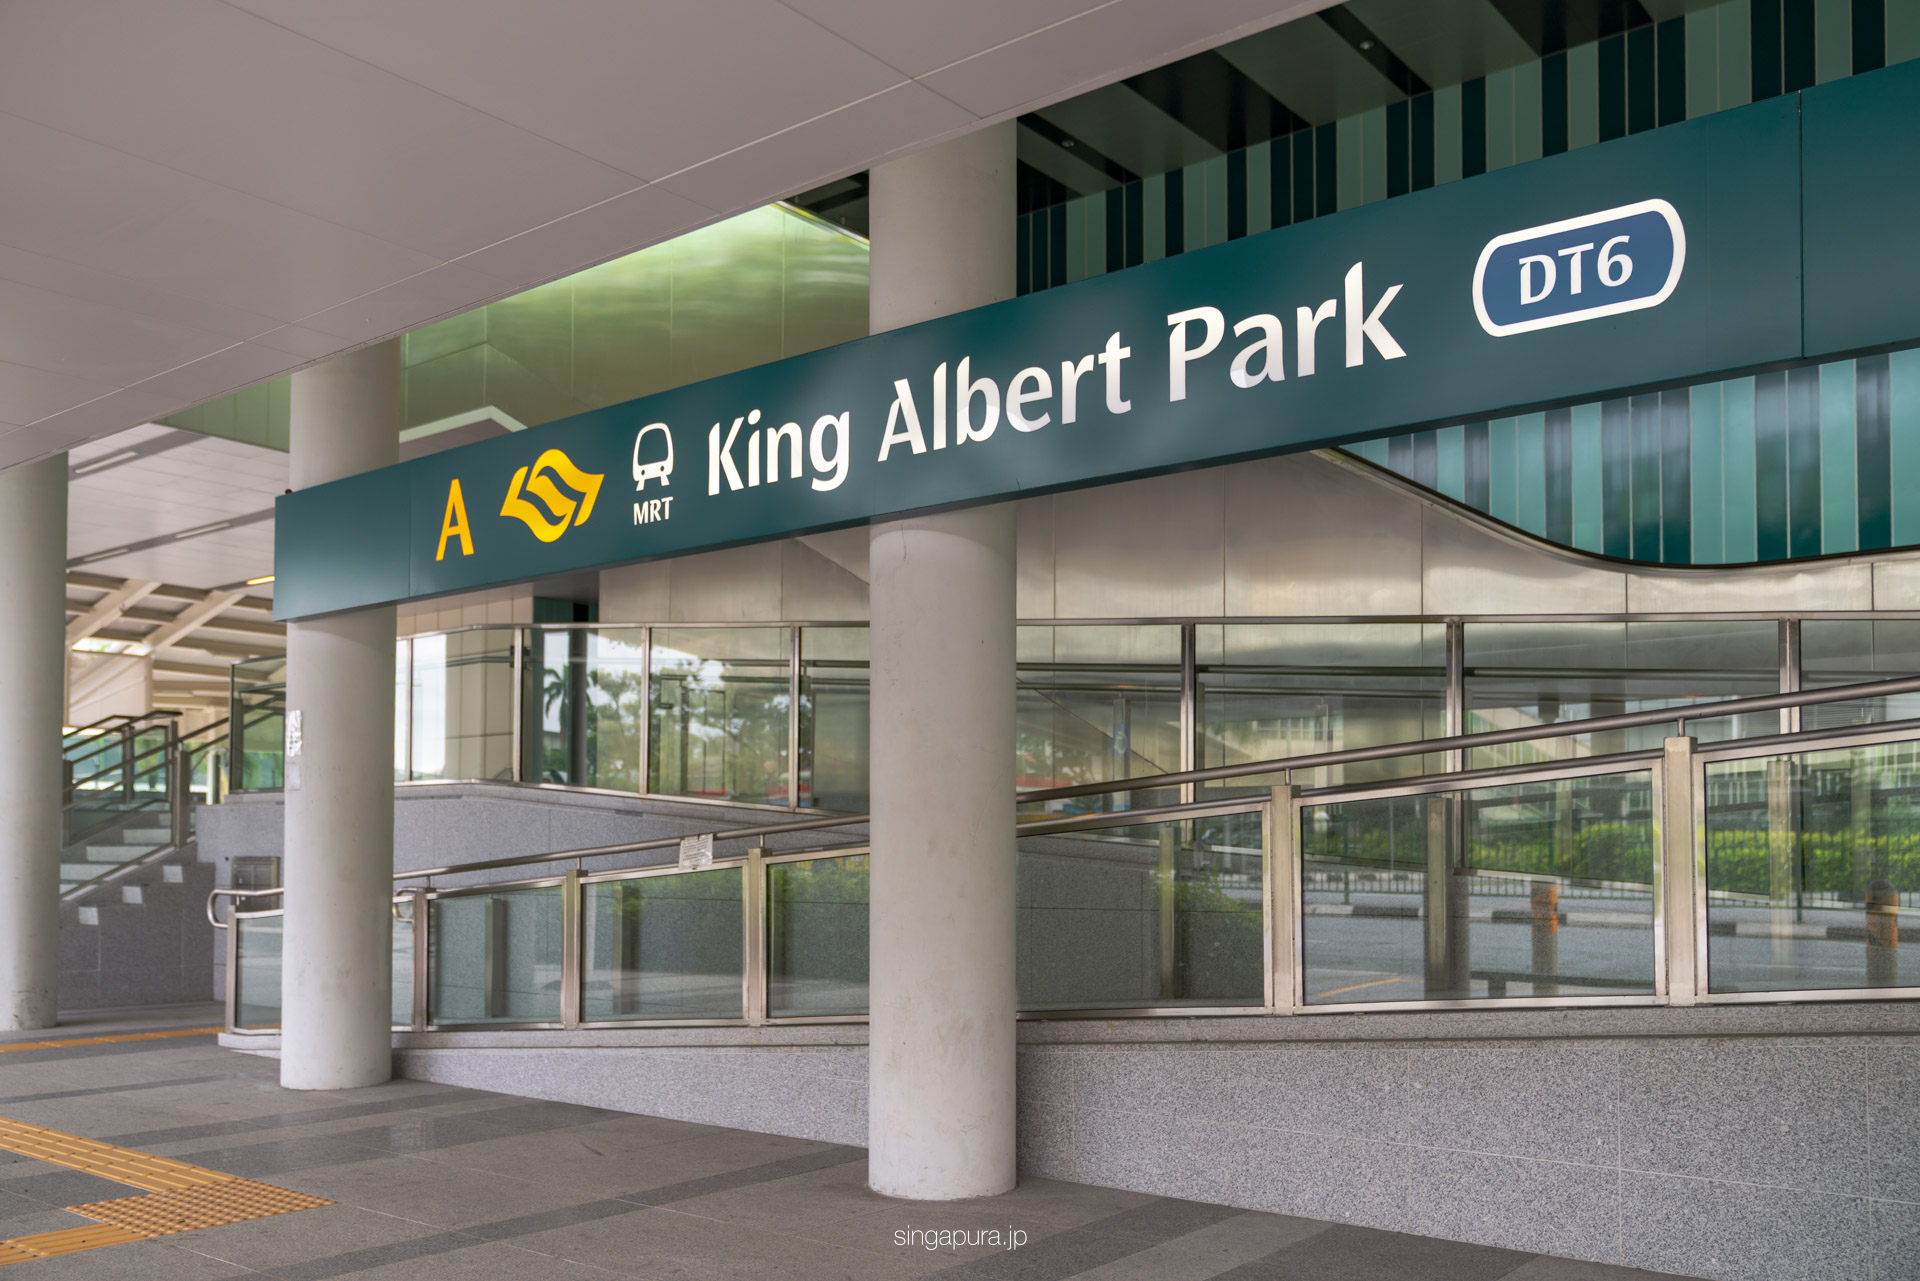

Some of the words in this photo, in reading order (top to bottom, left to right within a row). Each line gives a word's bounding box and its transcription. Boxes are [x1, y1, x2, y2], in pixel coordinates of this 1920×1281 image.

[1518, 235, 1634, 306] DT6
[708, 408, 850, 496] King
[877, 331, 1132, 463] Albert
[1167, 261, 1407, 403] Park
[435, 478, 475, 561] A
[632, 496, 674, 526] MRT
